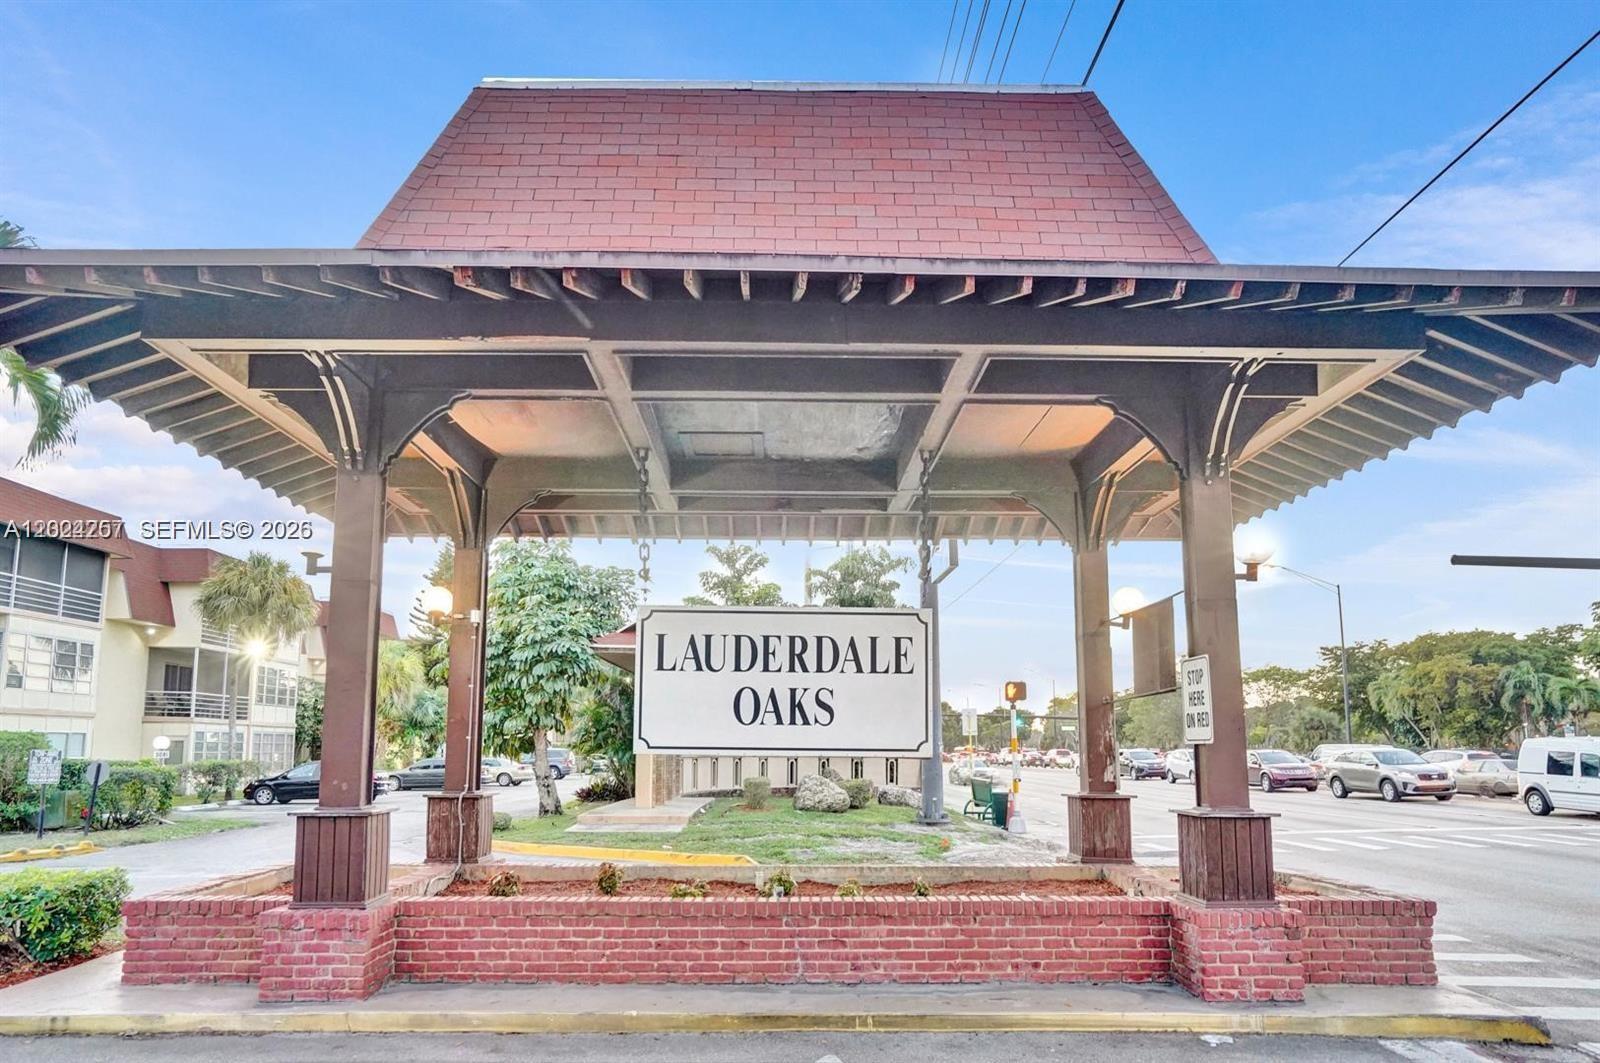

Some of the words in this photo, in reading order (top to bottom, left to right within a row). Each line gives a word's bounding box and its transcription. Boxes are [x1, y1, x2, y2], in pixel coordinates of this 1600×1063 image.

[654, 633, 915, 674] LAUDERDALE
[1186, 668, 1204, 686] STOP
[733, 686, 835, 727] OAKS
[1188, 690, 1205, 707] HERE
[1186, 712, 1196, 728] ON
[1196, 711, 1210, 728] RED
